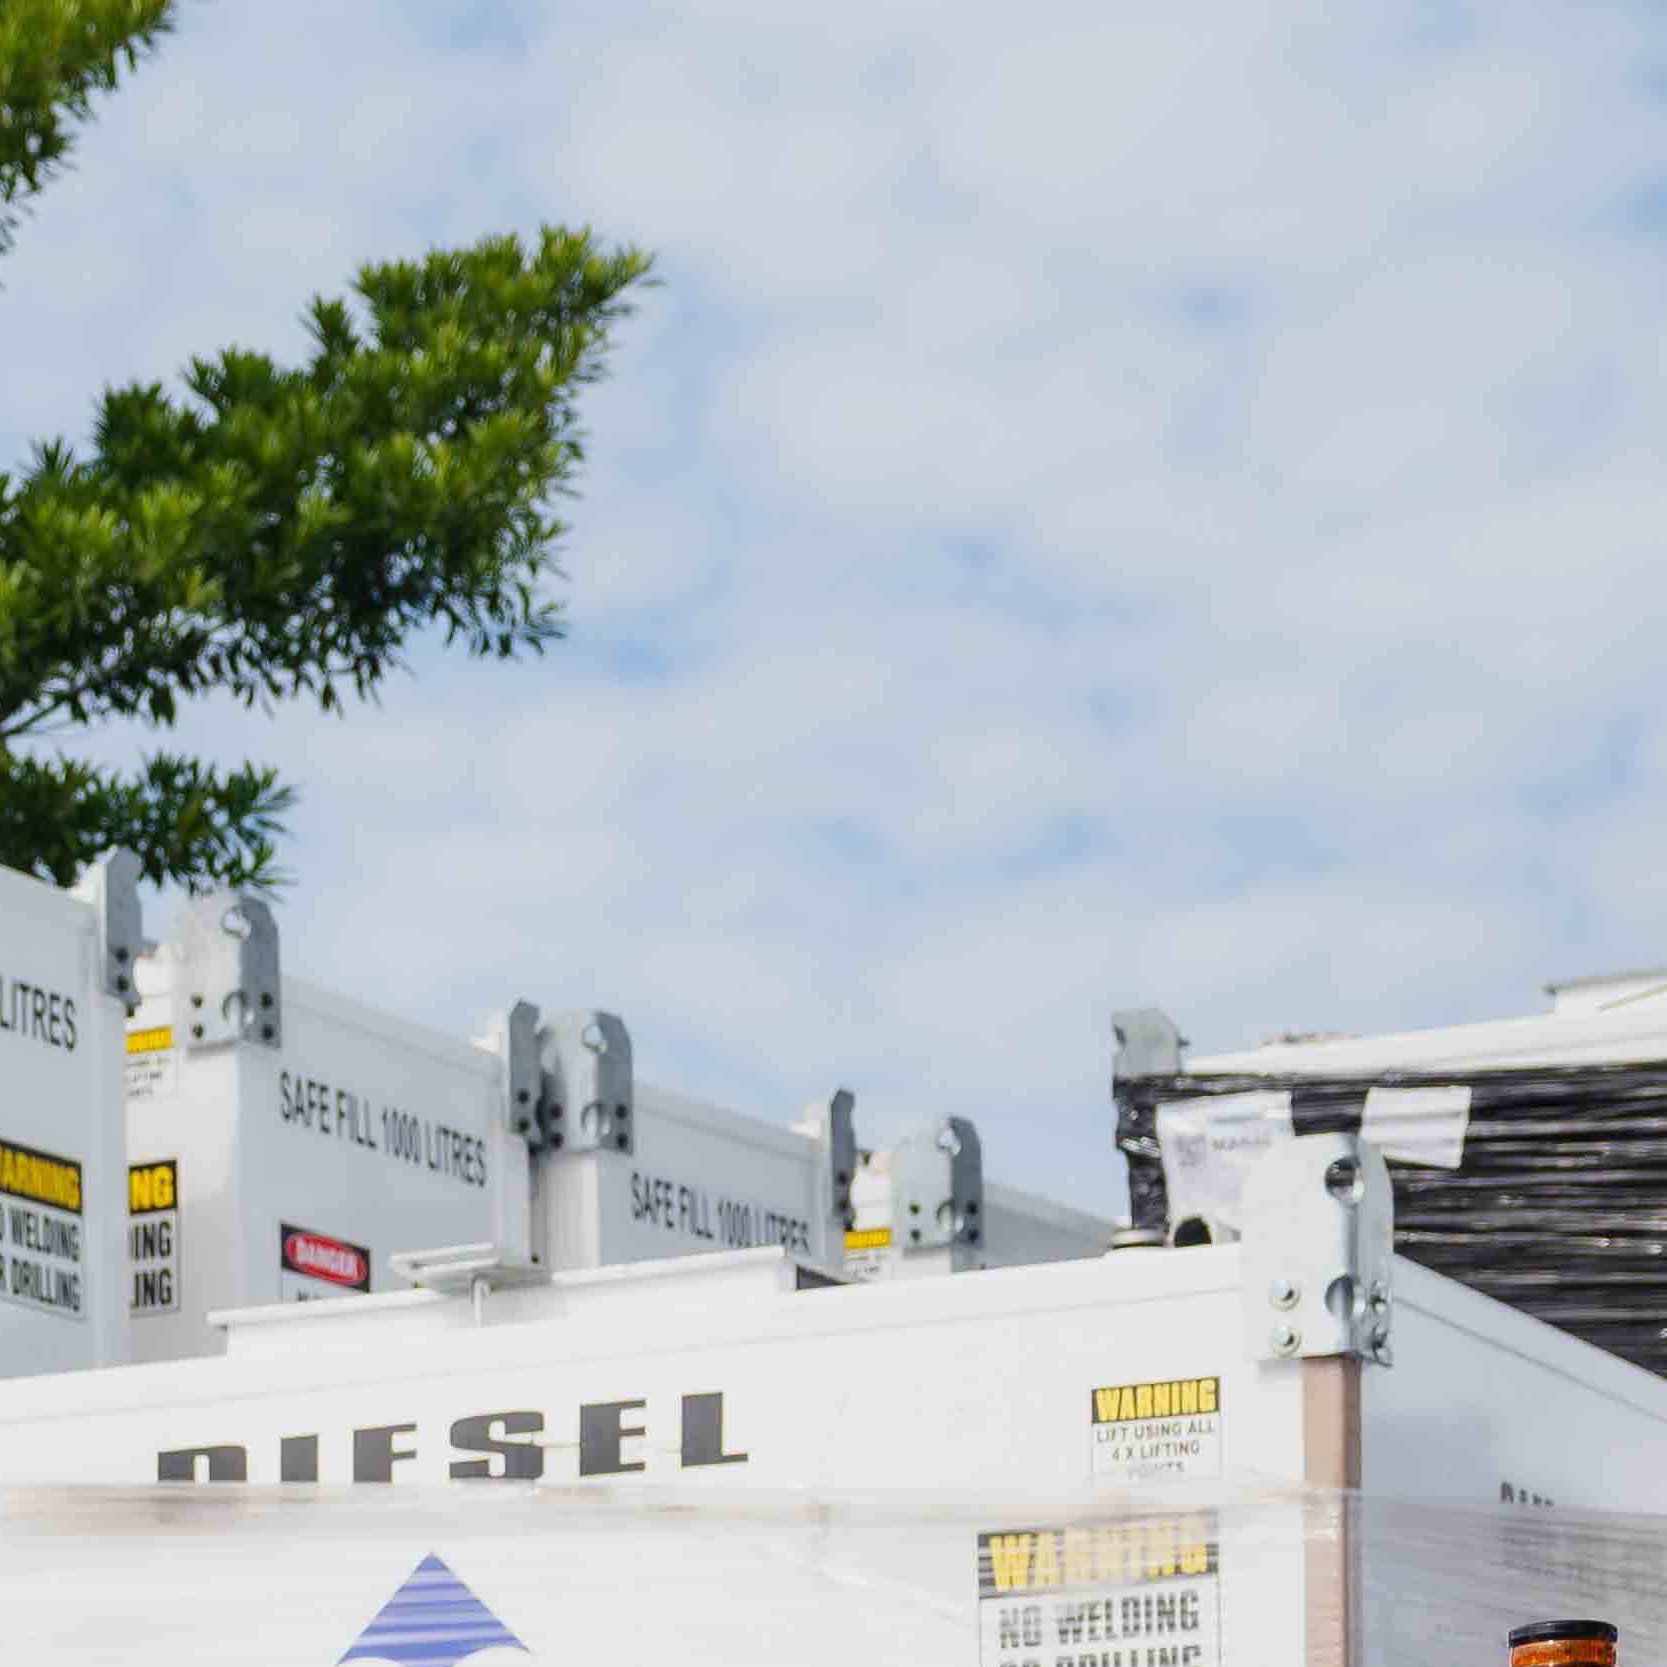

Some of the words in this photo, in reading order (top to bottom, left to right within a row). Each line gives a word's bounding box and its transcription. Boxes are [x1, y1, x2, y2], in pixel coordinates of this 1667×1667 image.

[0, 971, 76, 1052] LITRES
[280, 1068, 330, 1134] SAFE
[336, 1087, 376, 1149] FILL
[427, 1120, 486, 1188] LITRES
[631, 1172, 674, 1228] SAFE
[679, 1185, 713, 1239] FILL
[1097, 1378, 1217, 1422] WARNING
[1097, 1428, 1128, 1443] LIFT
[1135, 1424, 1182, 1439] USING
[1187, 1420, 1214, 1434] ALL
[1141, 1441, 1200, 1459] LIFTING
[1057, 1590, 1200, 1645] WELDING
